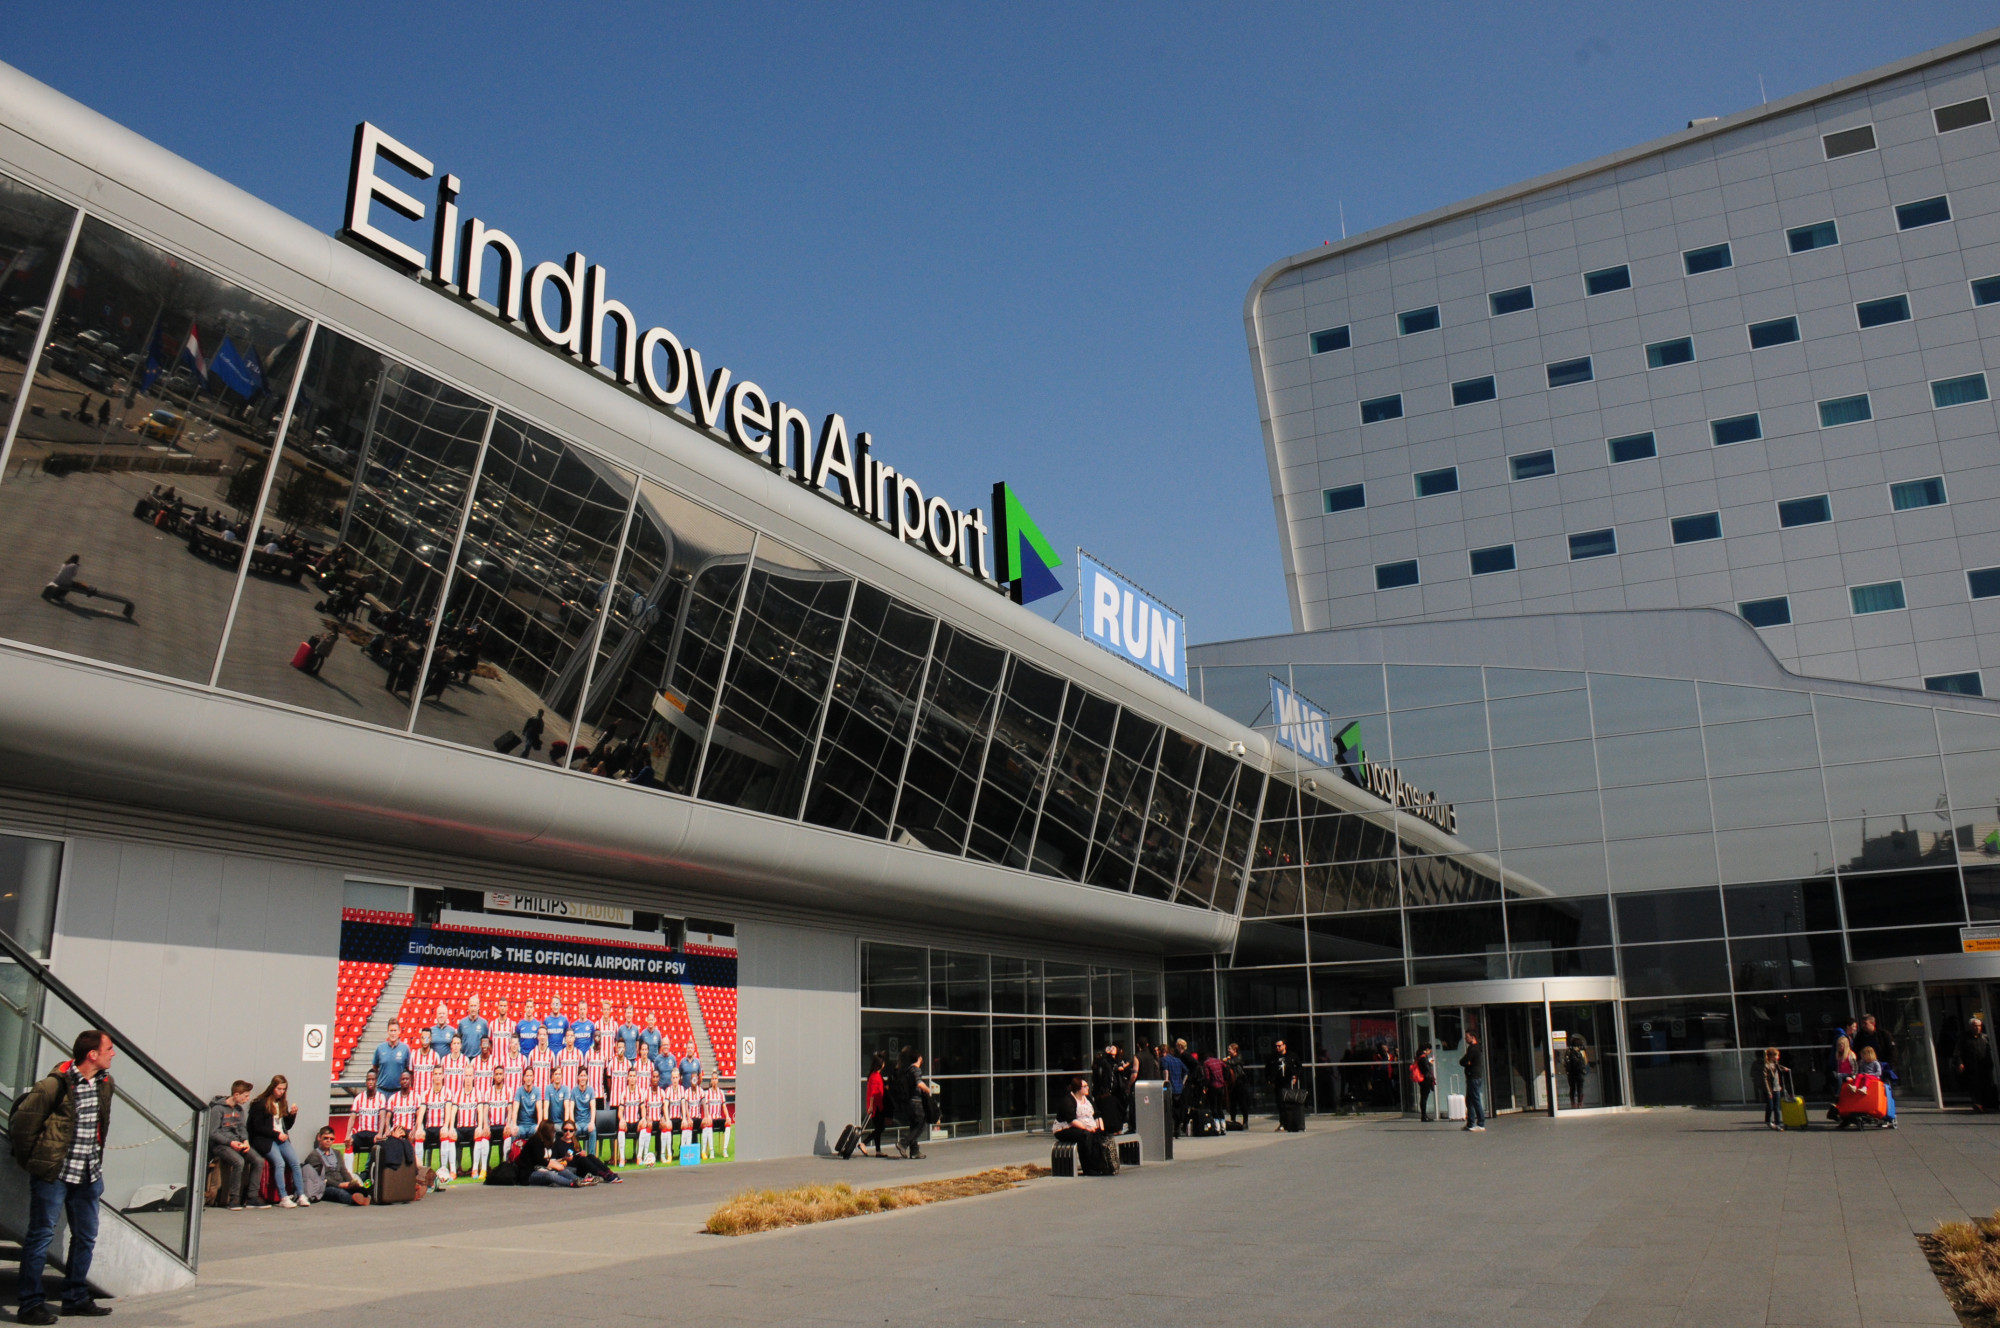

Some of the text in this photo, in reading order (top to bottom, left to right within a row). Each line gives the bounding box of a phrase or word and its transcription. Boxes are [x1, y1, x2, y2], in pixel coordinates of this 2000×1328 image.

[343, 121, 990, 579] EindhovenAirport
[1092, 572, 1176, 677] RUN
[408, 941, 686, 975] EindhovenAirport THE OFFICIAL AIRPORT OF PSV
